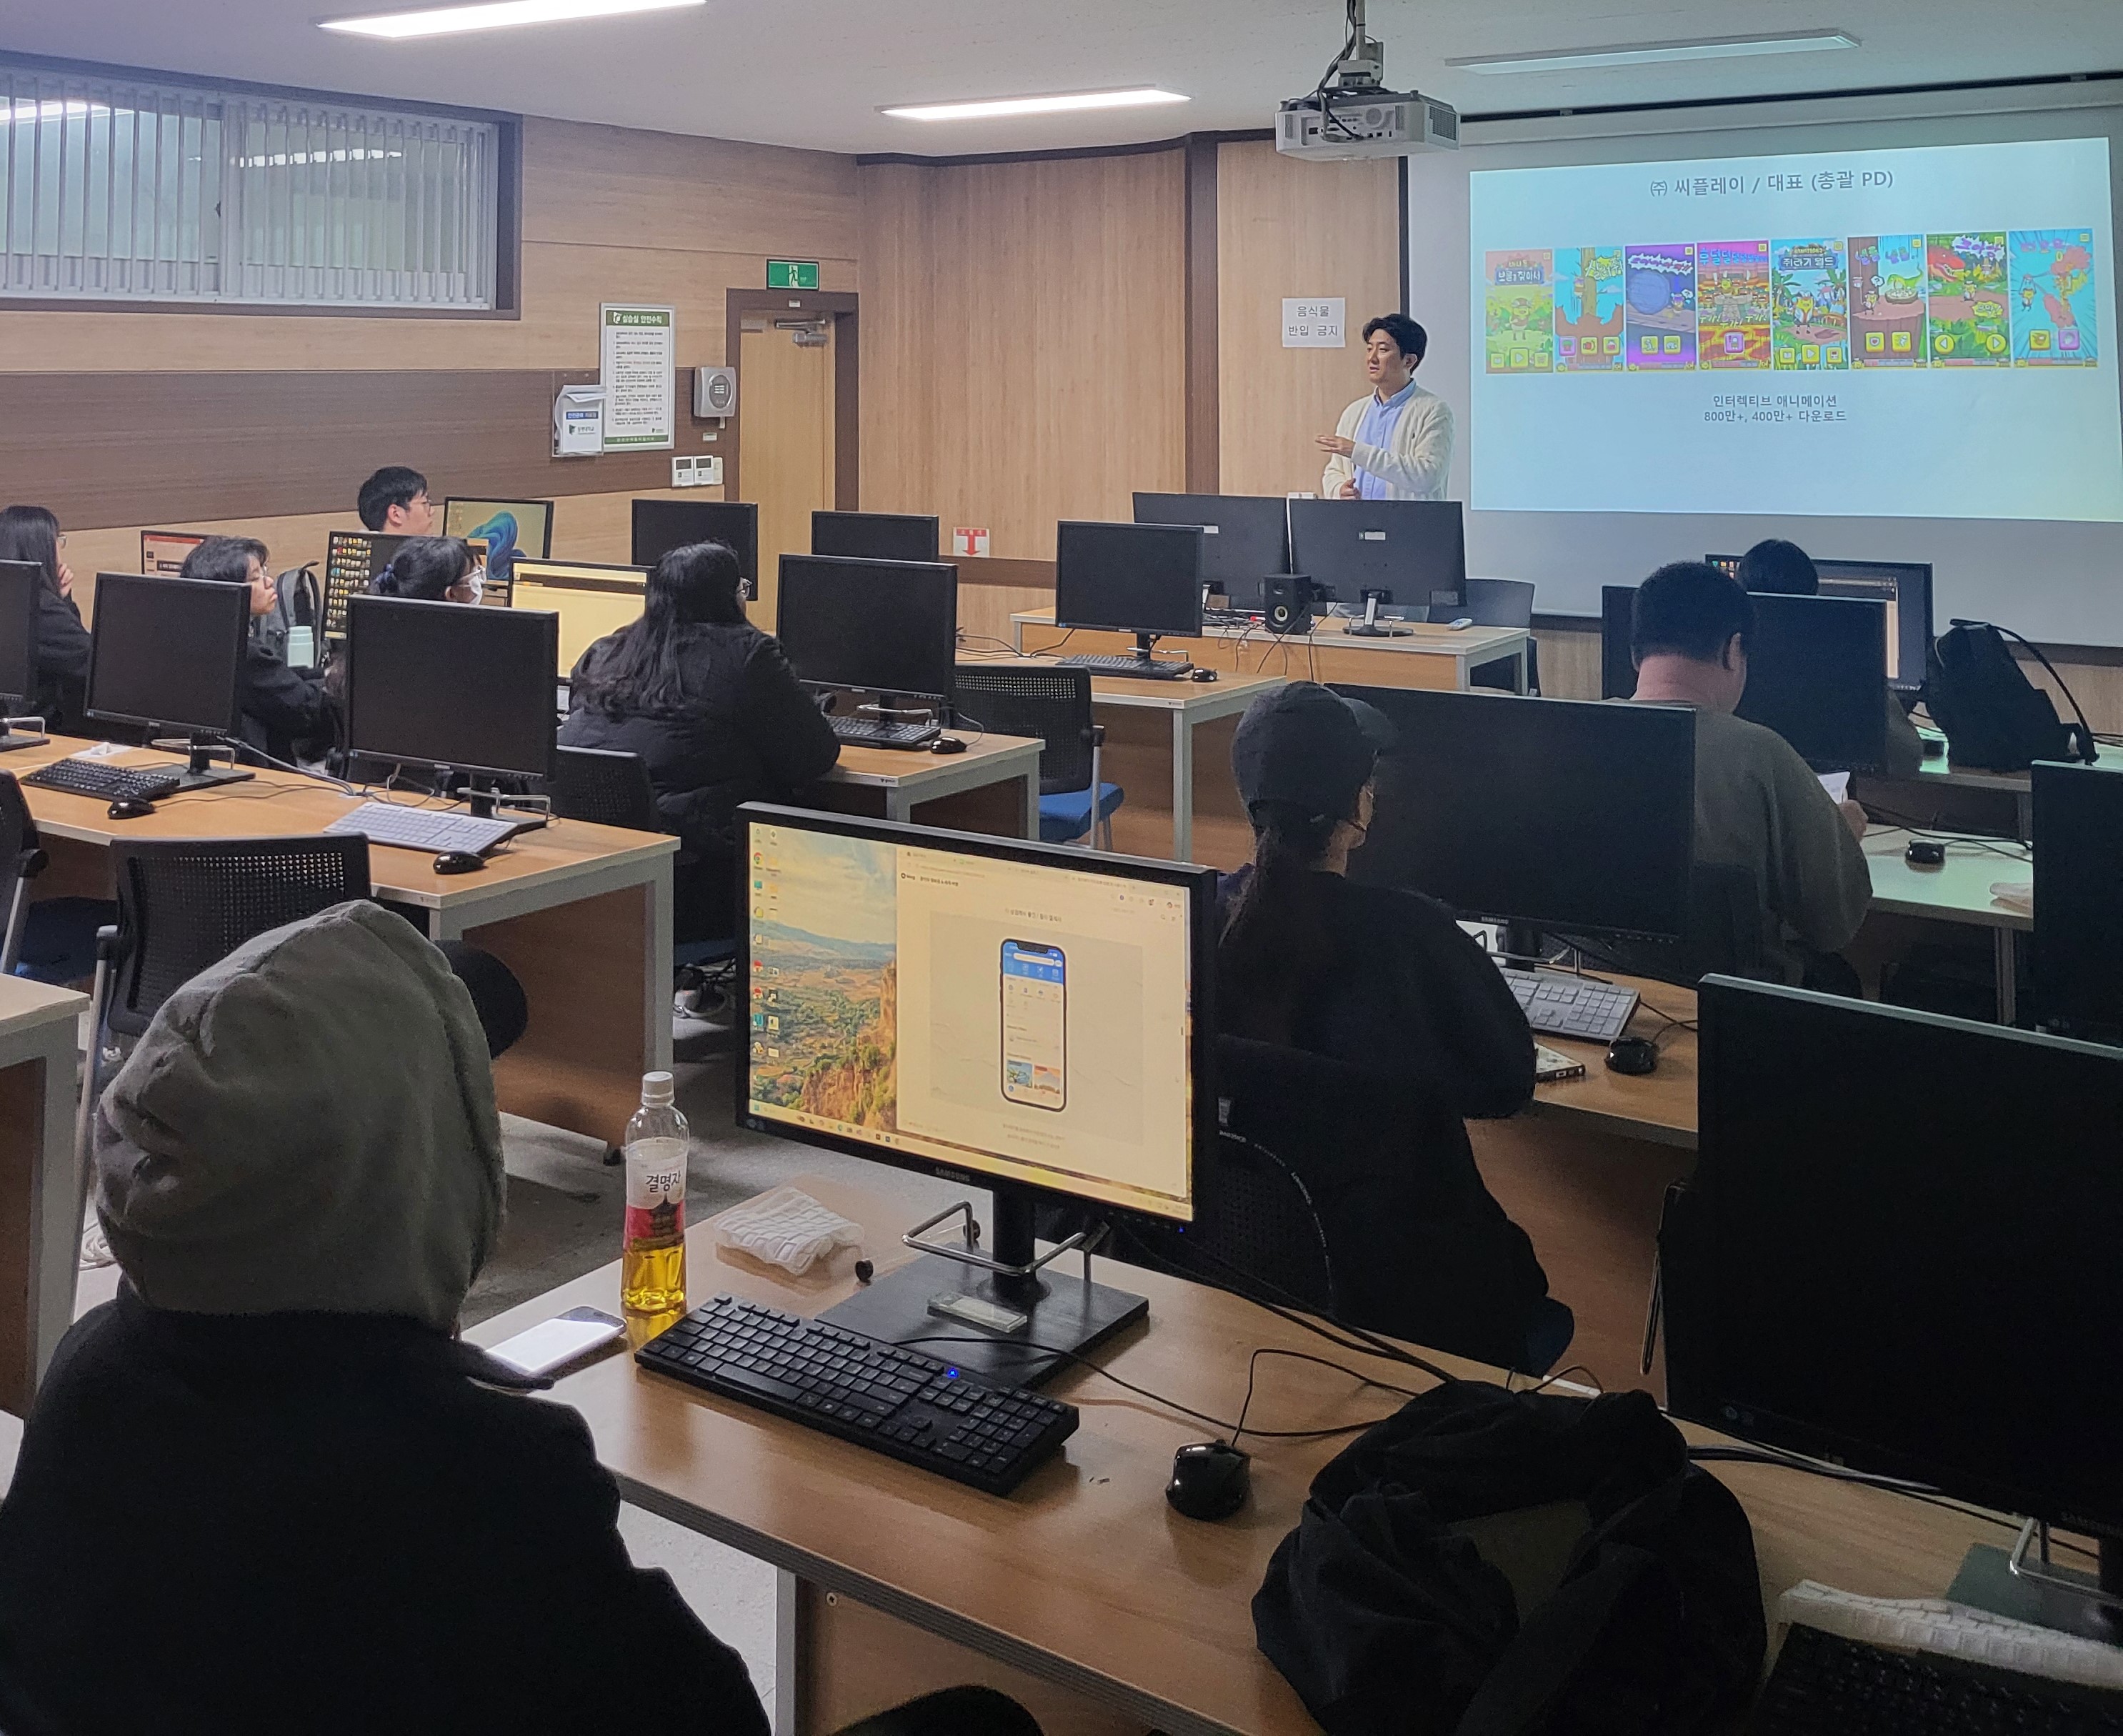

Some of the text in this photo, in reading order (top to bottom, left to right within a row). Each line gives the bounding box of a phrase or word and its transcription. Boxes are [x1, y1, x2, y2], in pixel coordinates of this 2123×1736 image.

[1674, 176, 1744, 196] 씨플레이
[1767, 174, 1804, 192] 대표
[1812, 170, 1854, 191] (총괄
[1862, 171, 1894, 188] PD)
[1783, 257, 1812, 267] 쥐라기
[1297, 306, 1329, 317] 음식물
[1288, 325, 1337, 336] 반입 금지
[1713, 394, 1837, 408] 인터렉티브 애니메이션
[1704, 409, 1847, 423] 800만+, 400만+ 다운로드
[646, 1169, 681, 1193] 결명자
